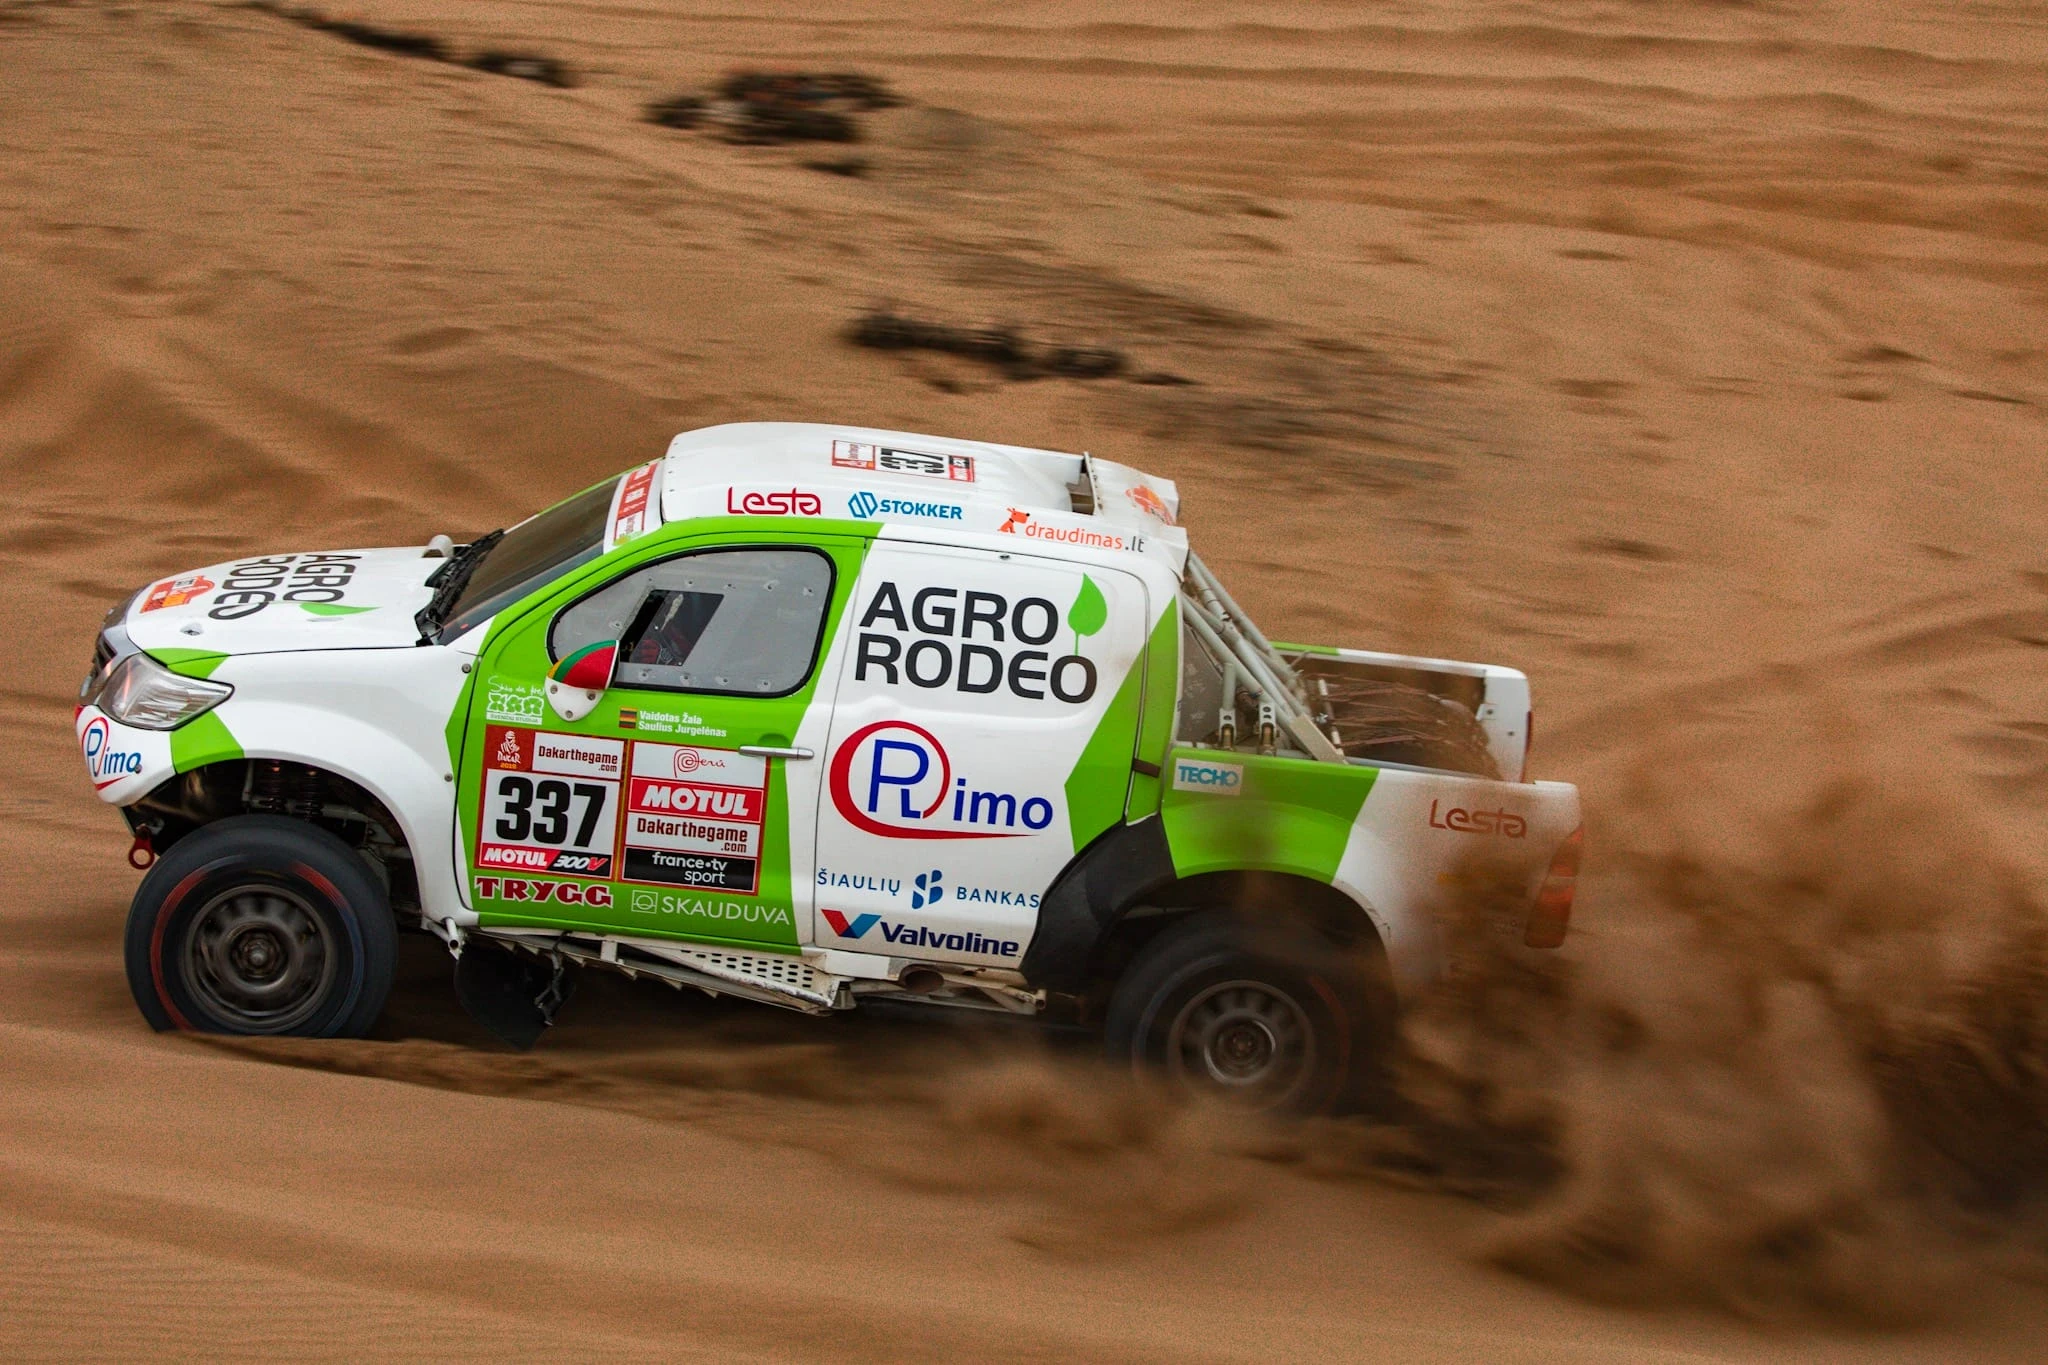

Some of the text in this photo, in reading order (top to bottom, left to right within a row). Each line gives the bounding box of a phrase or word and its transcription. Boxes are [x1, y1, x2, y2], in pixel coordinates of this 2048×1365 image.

[727, 486, 822, 516] Lesta
[879, 500, 963, 520] STOKKER
[1025, 521, 1145, 553] draudimas.lt
[283, 554, 363, 603] AGRO
[859, 581, 1059, 646] AGRO
[854, 633, 1098, 703] RODEO
[638, 721, 673, 733] Saulius
[639, 710, 703, 725] Vaidotas Žala
[538, 745, 618, 765] Dakarthegame
[598, 763, 617, 773] .com
[1178, 765, 1239, 787] TECHO
[496, 776, 607, 848] 337
[640, 784, 749, 817] MOTUL
[637, 817, 748, 843] Dakarthegame
[1429, 799, 1528, 839] Lesta
[483, 847, 609, 872] MOTUL 300V
[720, 841, 747, 854] .com
[473, 875, 614, 909] TRYGG
[683, 869, 726, 886] sport
[816, 868, 1040, 909] ŠIAULIŲ BANKAS
[661, 895, 790, 926] SKAUDUVA
[880, 921, 1020, 957] Valvoline
